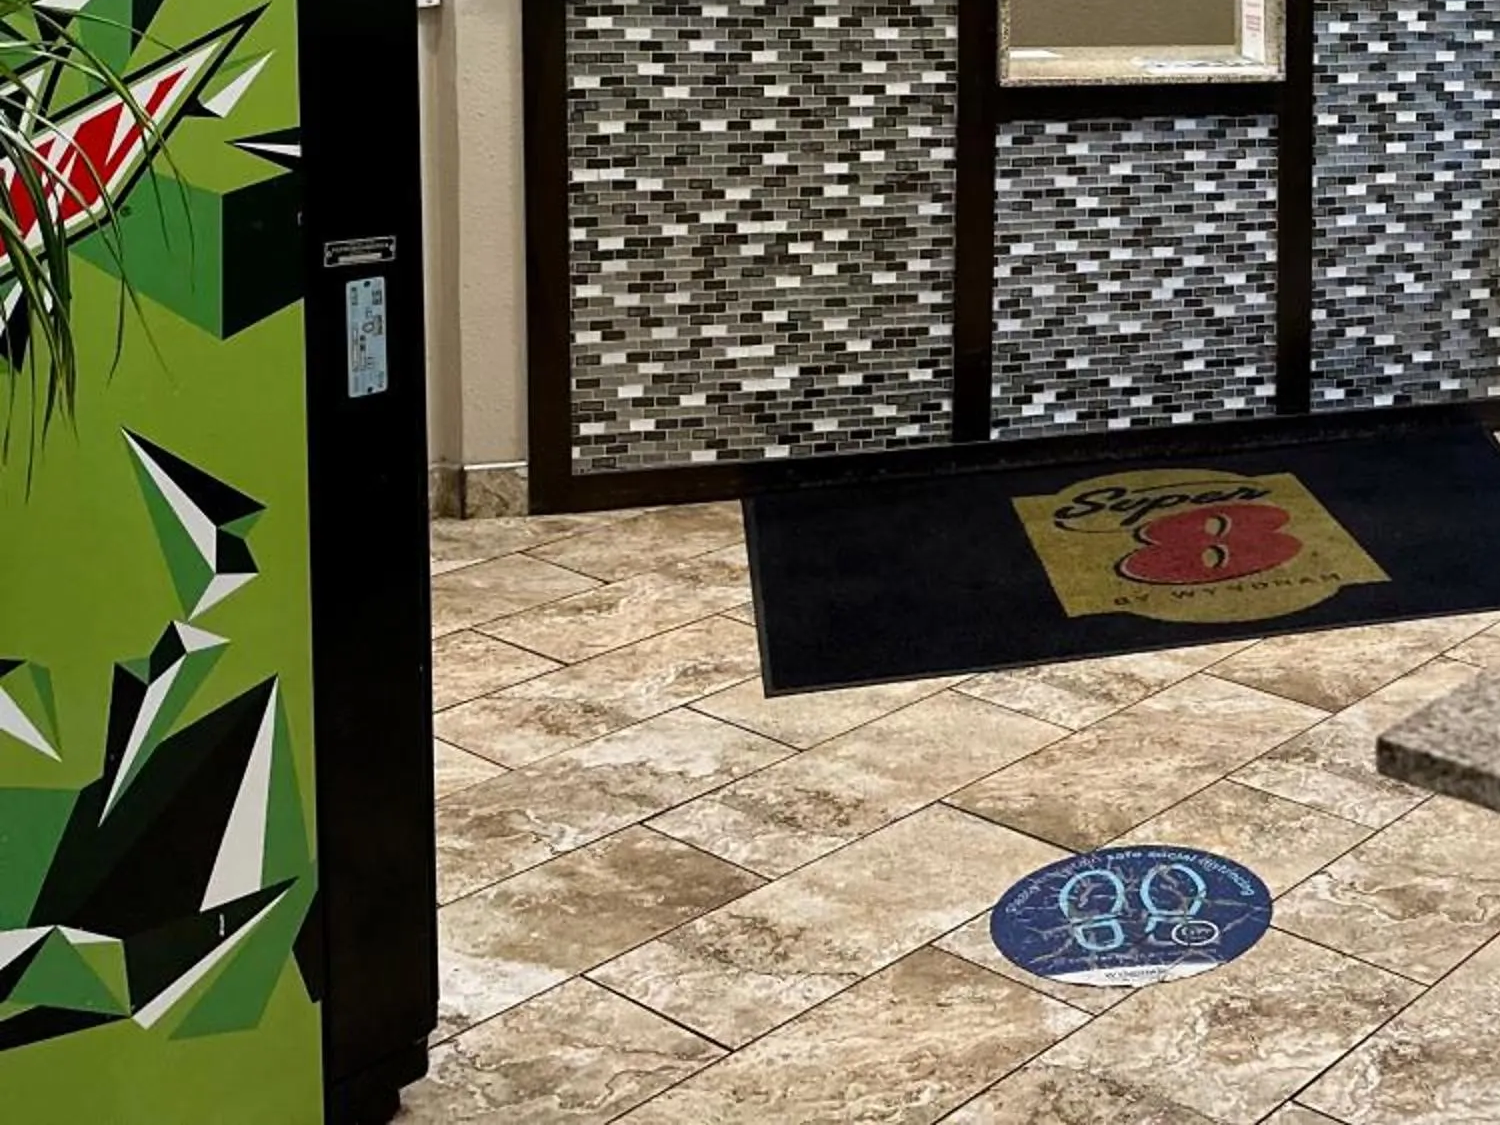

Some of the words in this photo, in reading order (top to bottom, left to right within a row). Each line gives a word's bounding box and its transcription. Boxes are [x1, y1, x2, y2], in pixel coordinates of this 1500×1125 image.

[1054, 486, 1271, 526] Super
[1114, 503, 1305, 586] 8
[1113, 592, 1151, 607] BY
[1171, 571, 1342, 601] WYNDHAM
